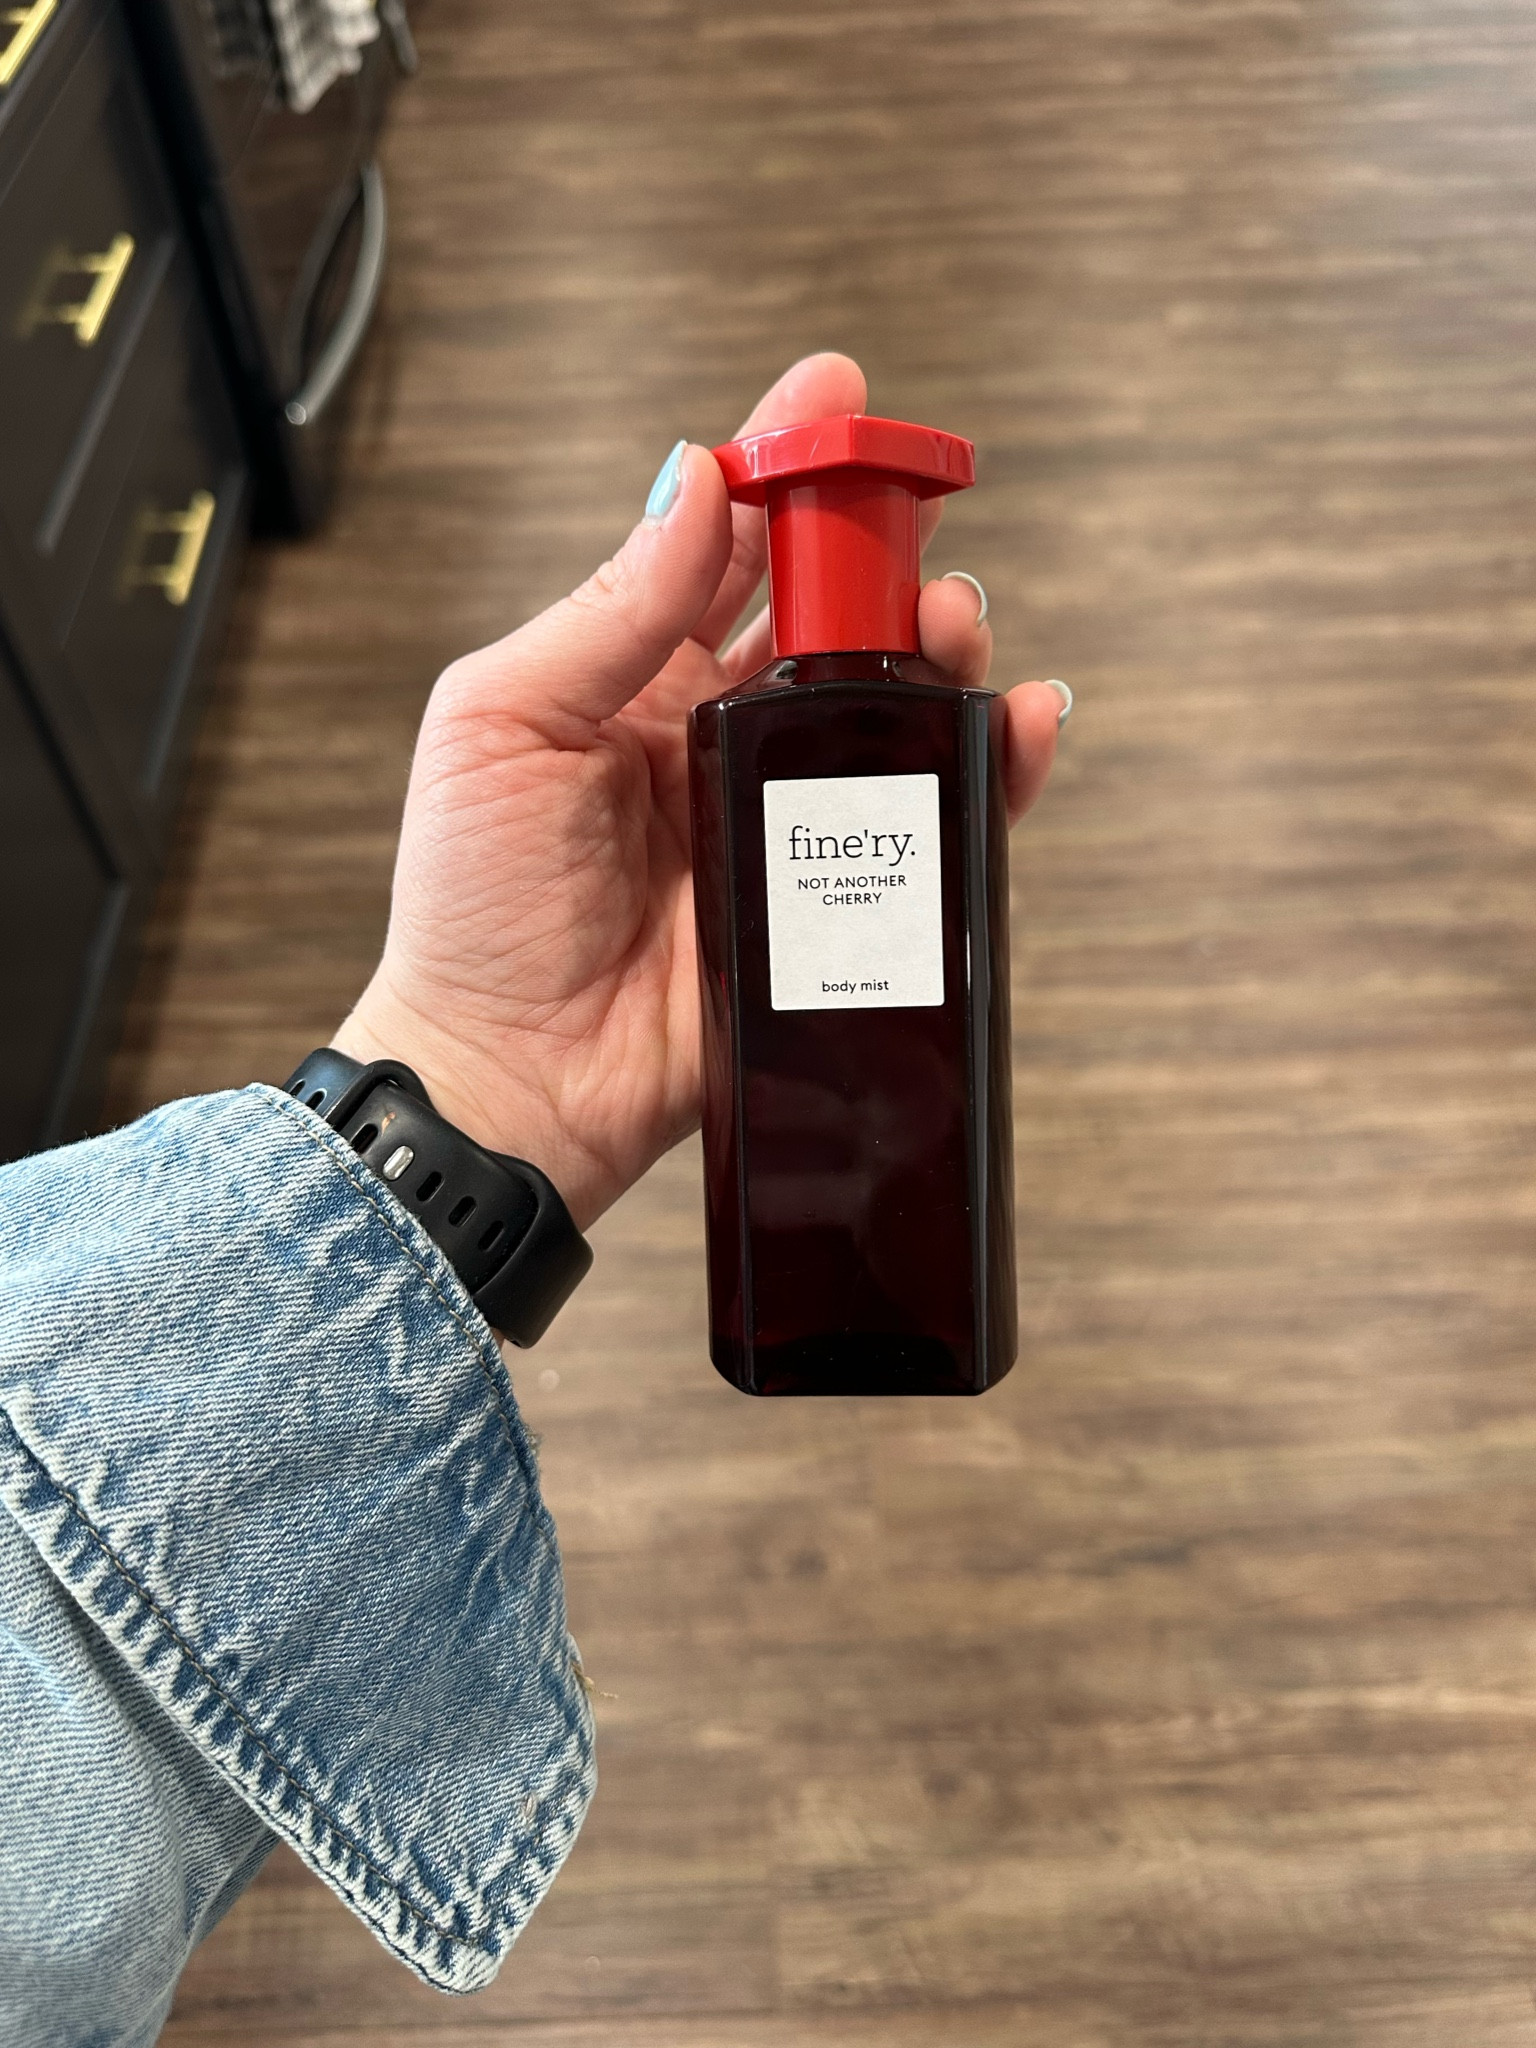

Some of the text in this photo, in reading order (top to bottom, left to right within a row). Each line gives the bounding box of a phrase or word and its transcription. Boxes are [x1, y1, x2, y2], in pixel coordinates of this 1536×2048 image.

[788, 825, 916, 867] fine'ry.
[798, 875, 907, 890] NOT ANOTHER
[822, 892, 882, 905] CHERRY
[822, 979, 889, 994] body mist
